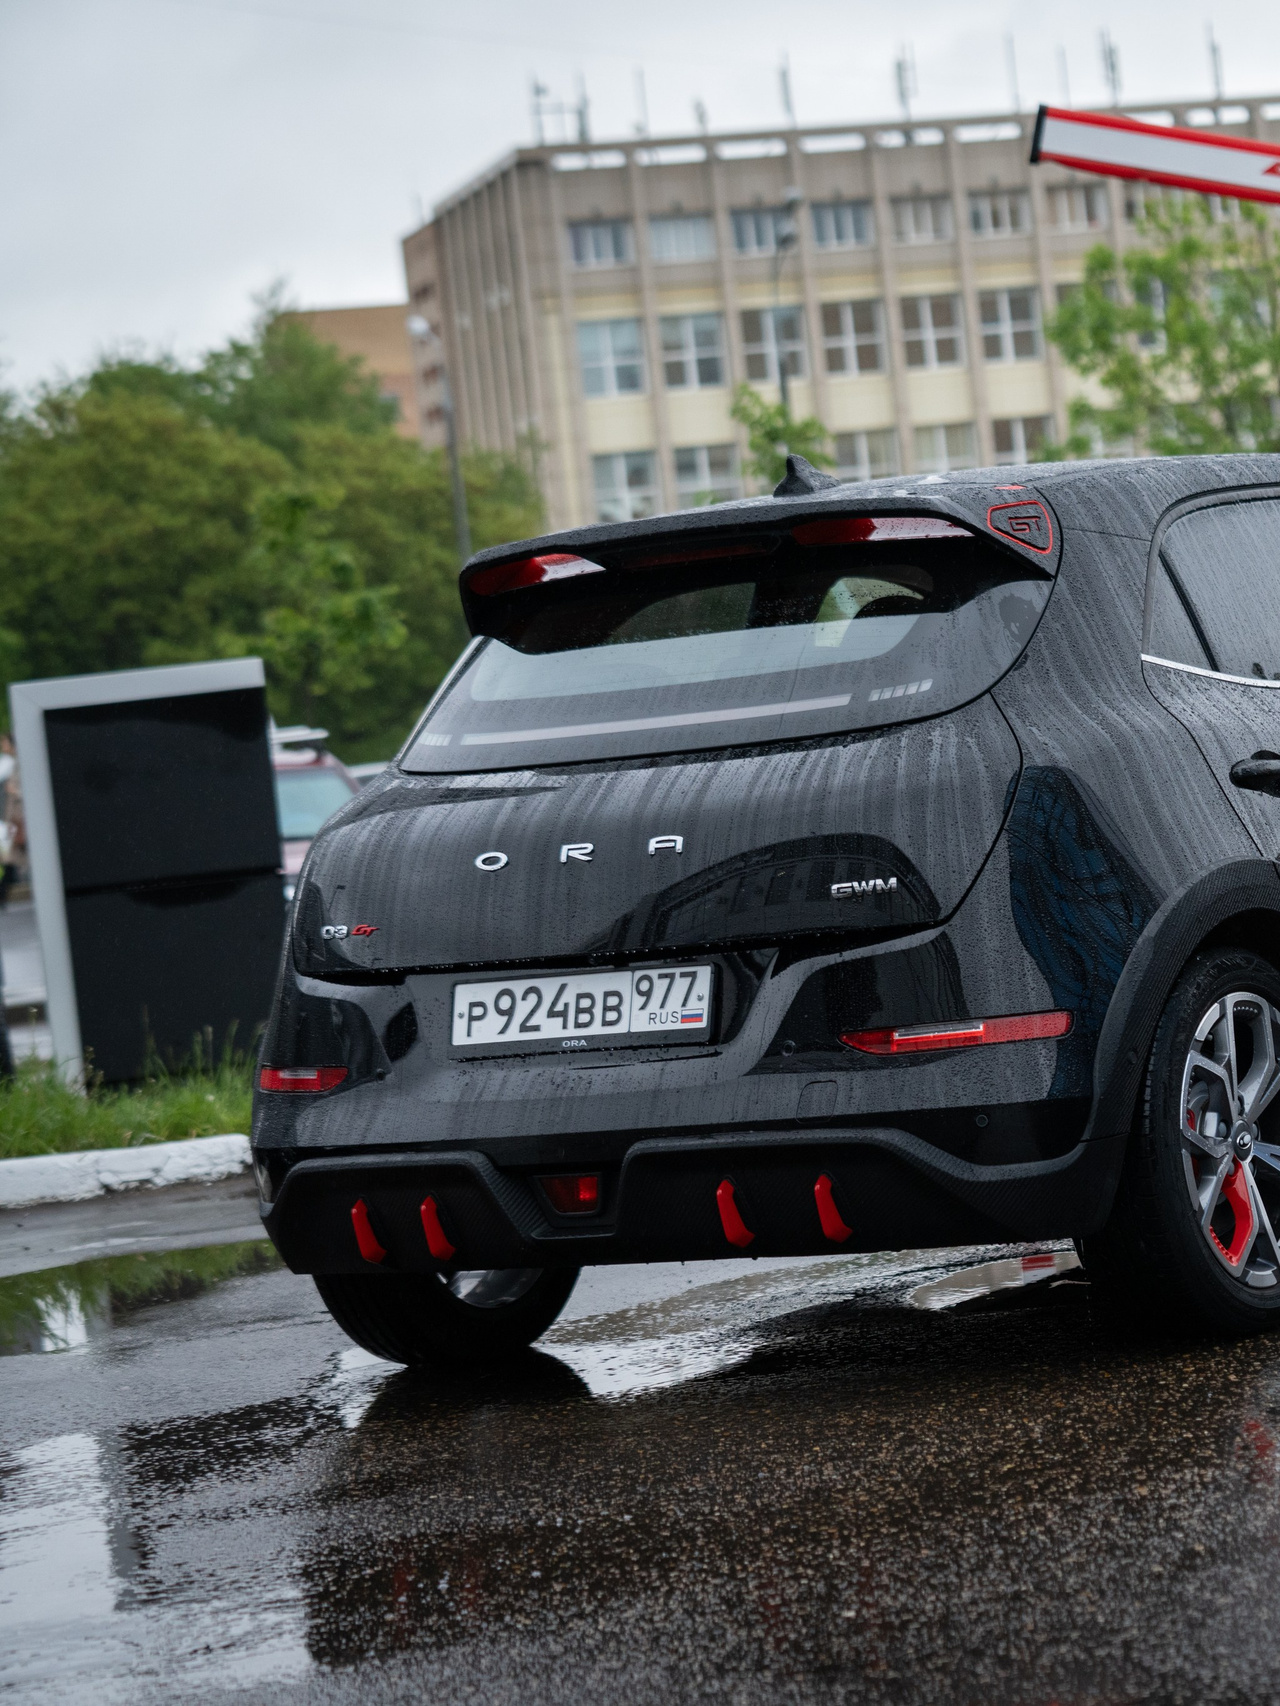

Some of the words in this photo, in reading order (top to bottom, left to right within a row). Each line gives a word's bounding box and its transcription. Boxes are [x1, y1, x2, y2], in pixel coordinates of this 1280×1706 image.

[831, 876, 897, 899] GWM
[322, 924, 348, 940] 03
[350, 924, 380, 937] GT
[635, 971, 698, 1011] 977
[649, 1011, 679, 1025] RUS
[562, 1039, 588, 1048] ORA
